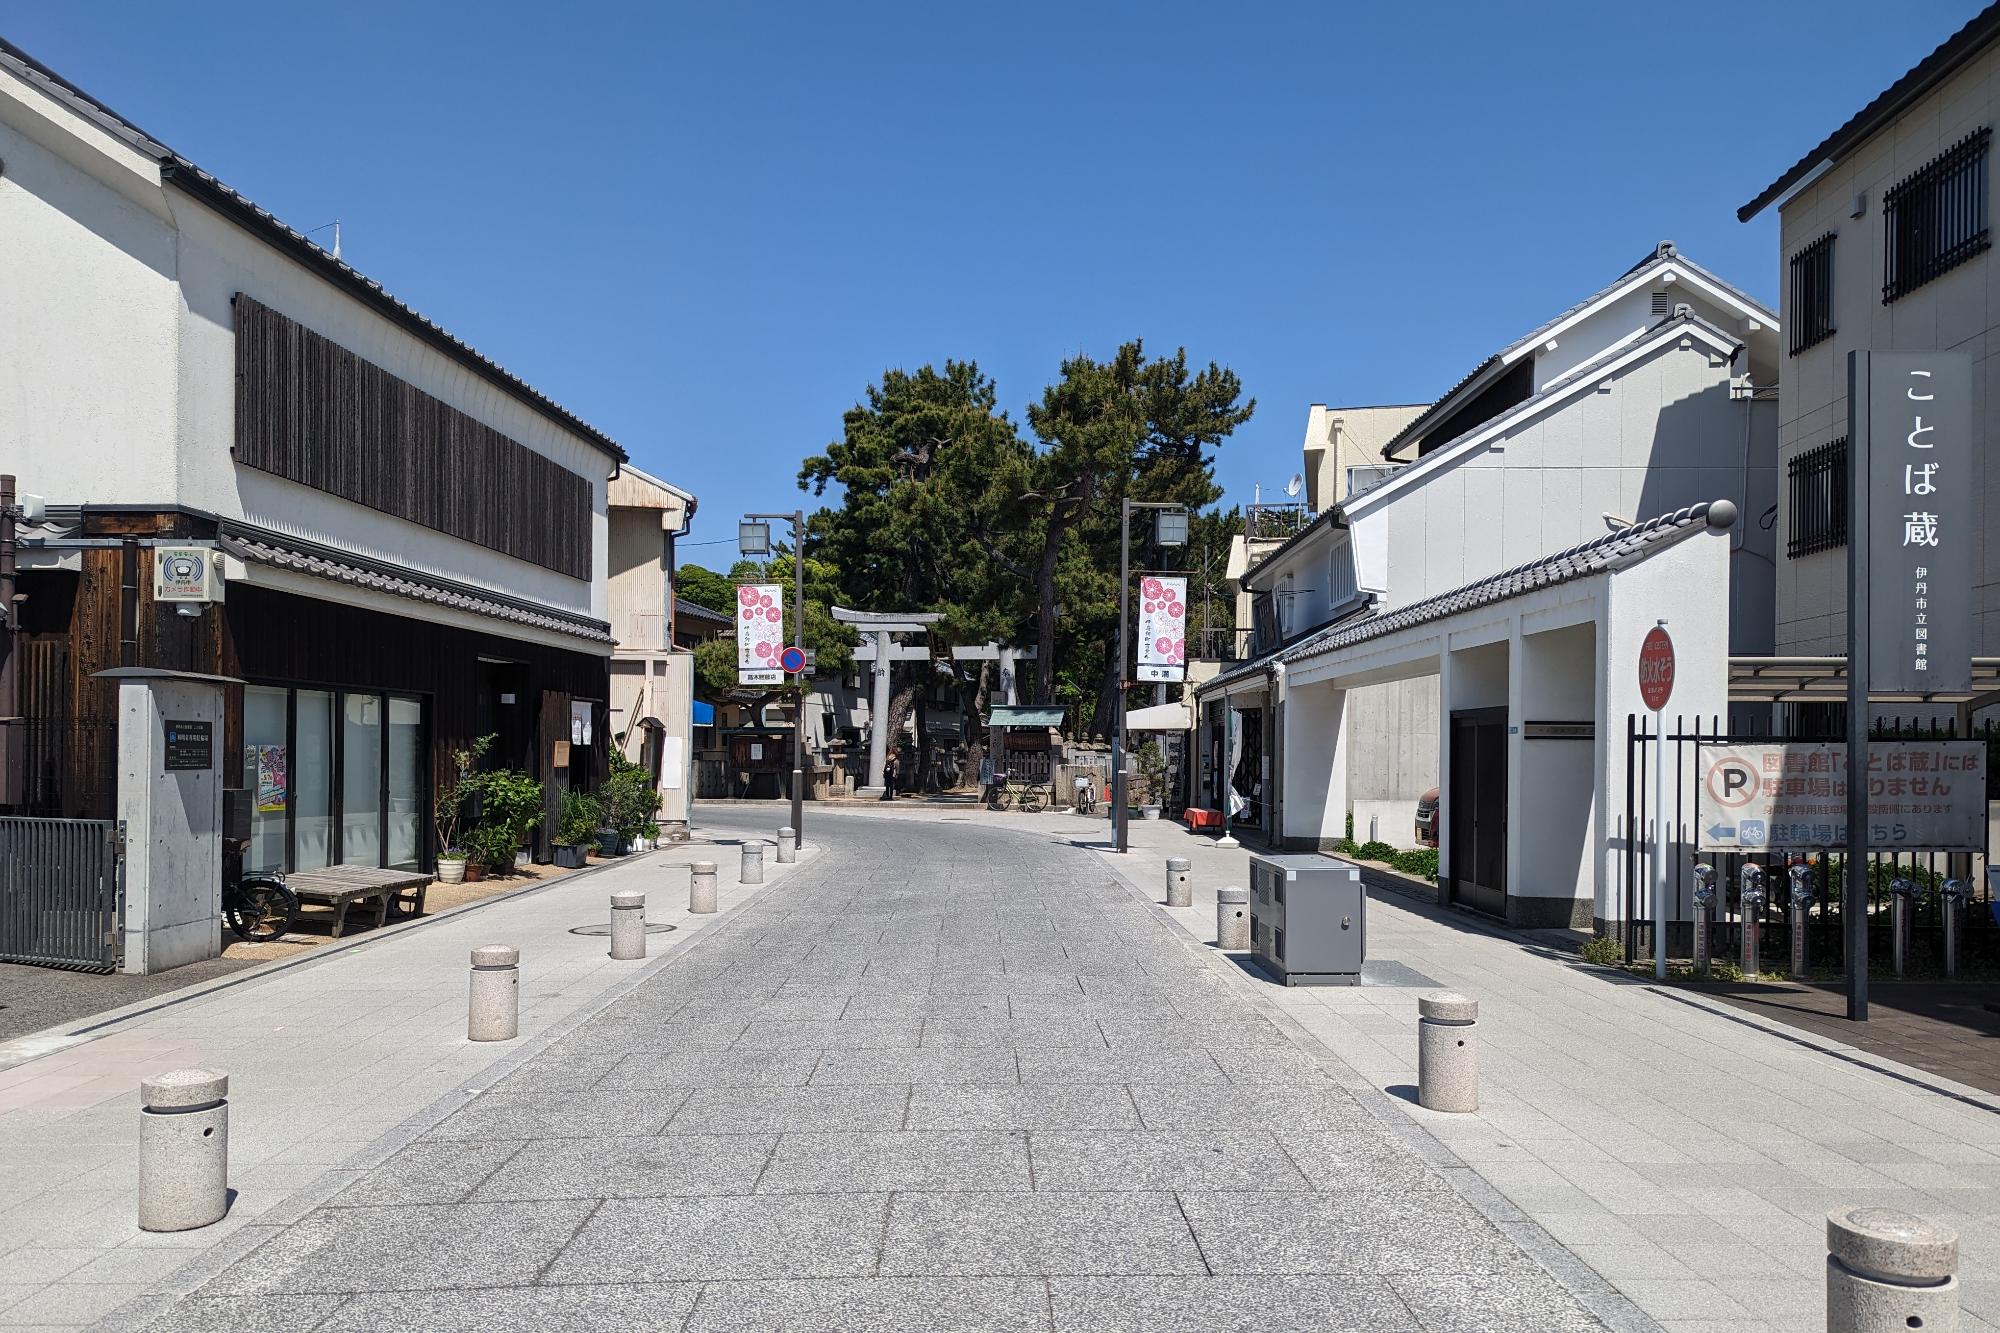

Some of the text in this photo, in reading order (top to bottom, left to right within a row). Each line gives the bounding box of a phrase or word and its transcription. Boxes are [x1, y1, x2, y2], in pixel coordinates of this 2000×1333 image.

[1902, 370, 1940, 547] ことば蔵
[1915, 566, 1928, 671] 伊丹市立図書館
[1762, 751, 1979, 773] 図書館「とば蔵」には
[1762, 777, 1951, 798] 駐車場はりません
[1770, 823, 1908, 842] 駐輪場はちら
